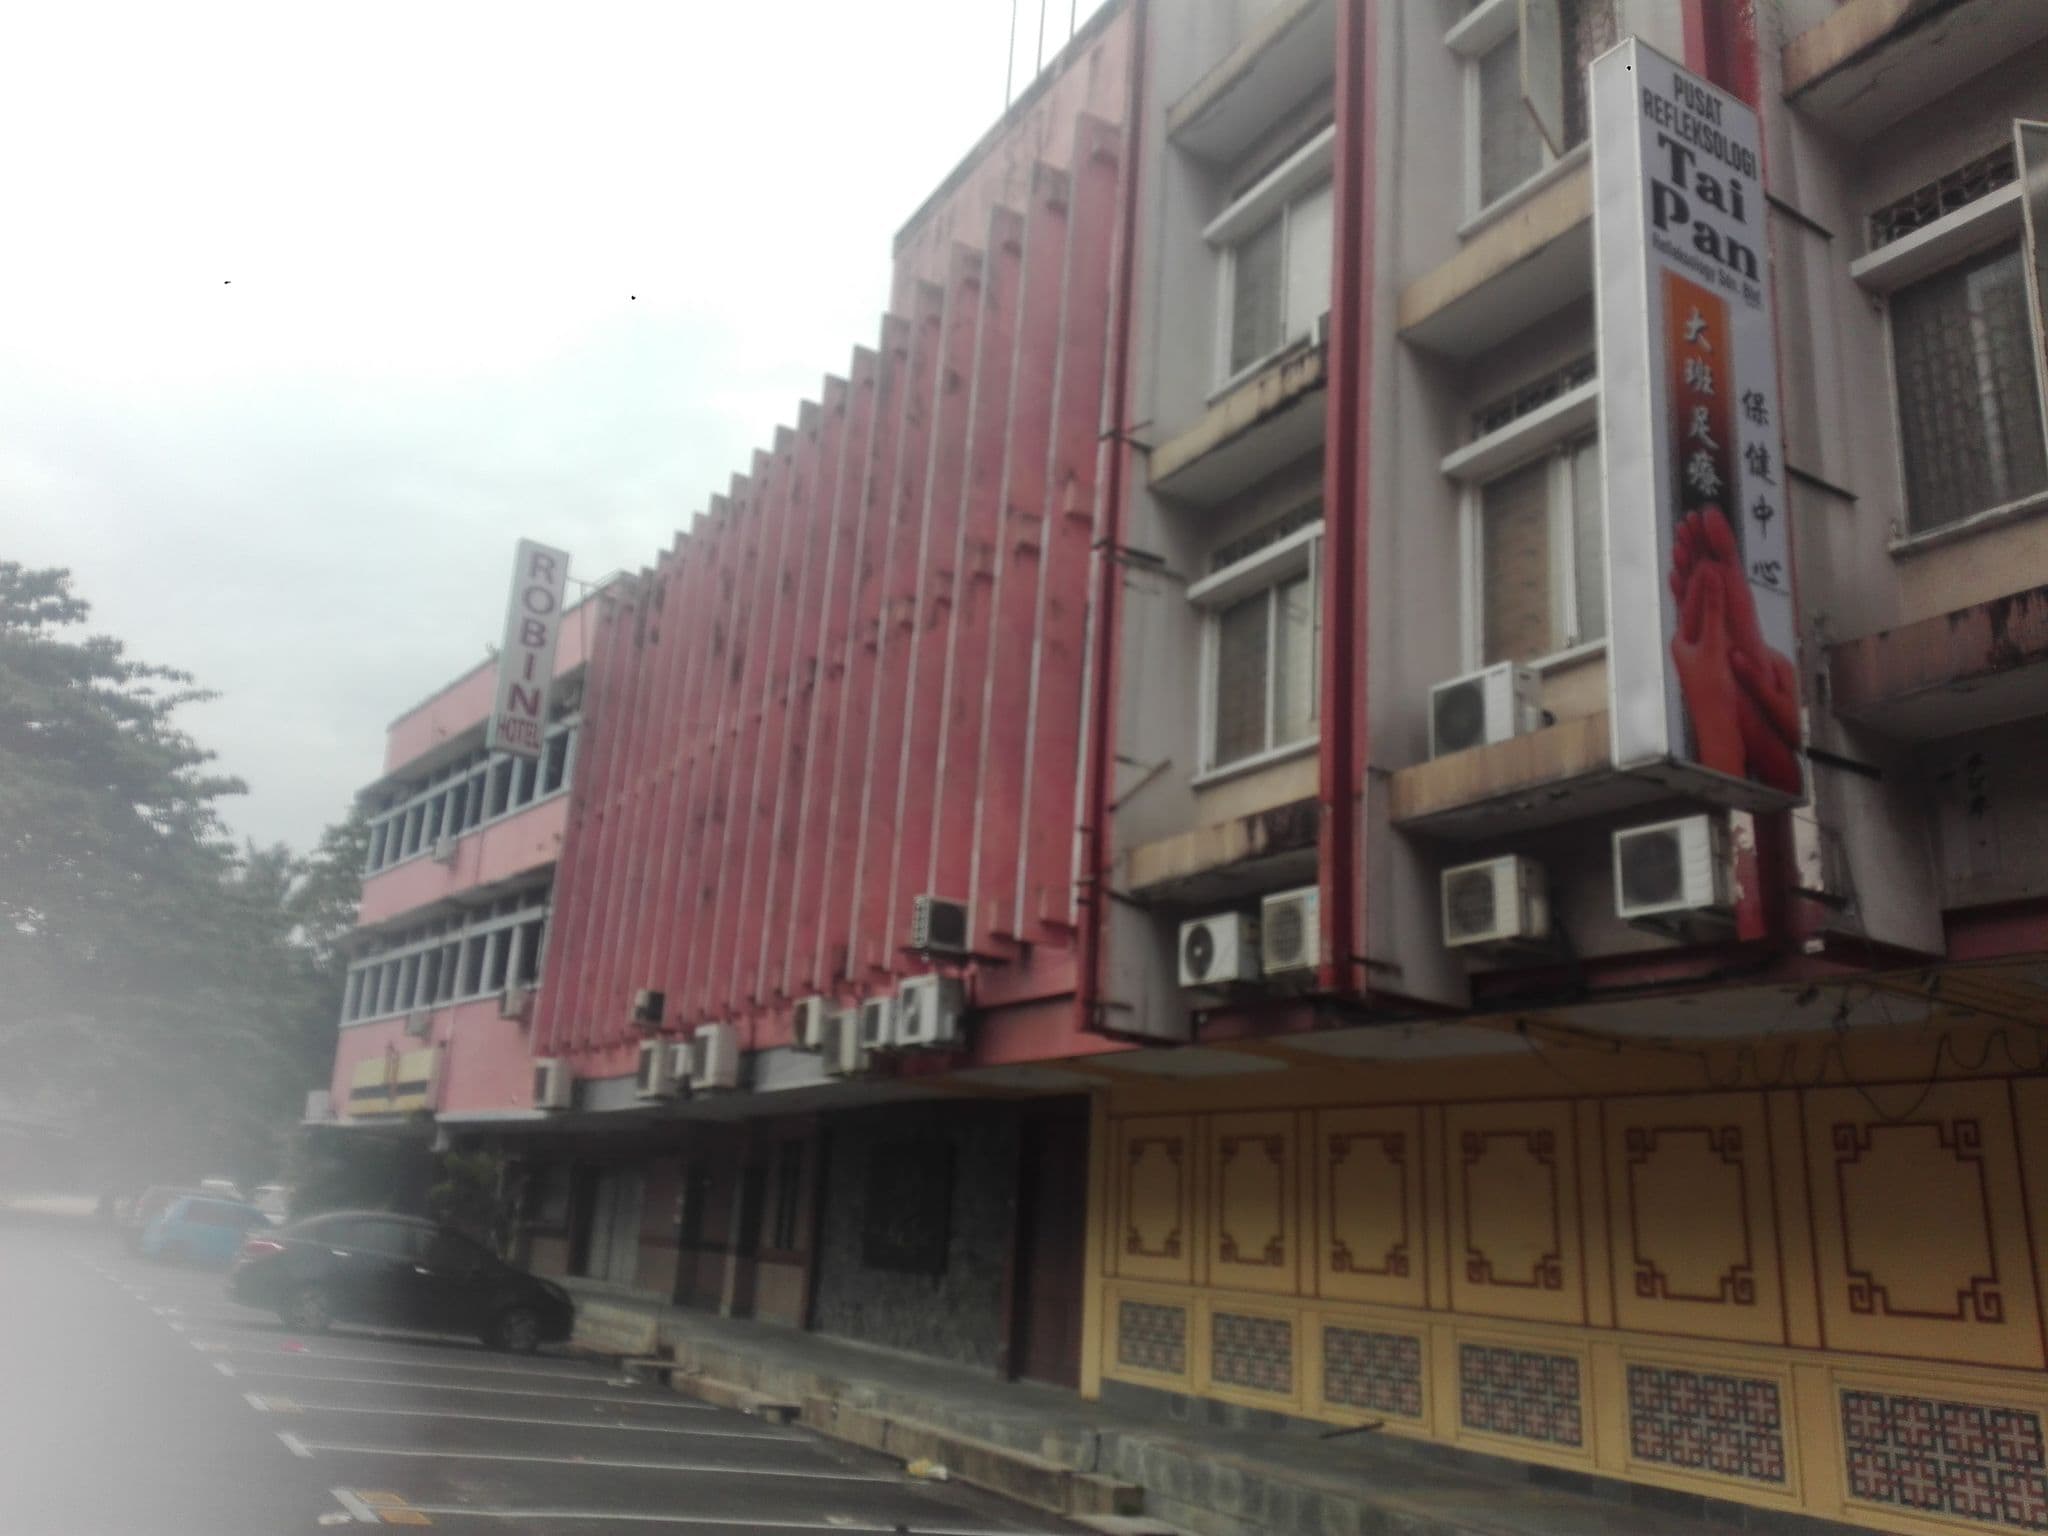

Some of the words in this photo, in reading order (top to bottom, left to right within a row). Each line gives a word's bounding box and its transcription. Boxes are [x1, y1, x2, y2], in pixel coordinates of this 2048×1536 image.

[1643, 88, 1756, 178] REFLEKSOLOGI
[1674, 74, 1722, 126] PUSAT
[1658, 132, 1747, 223] Tai
[1652, 178, 1759, 280] Pan
[1742, 390, 1782, 585] 保健中心
[508, 552, 555, 716] ROBIN
